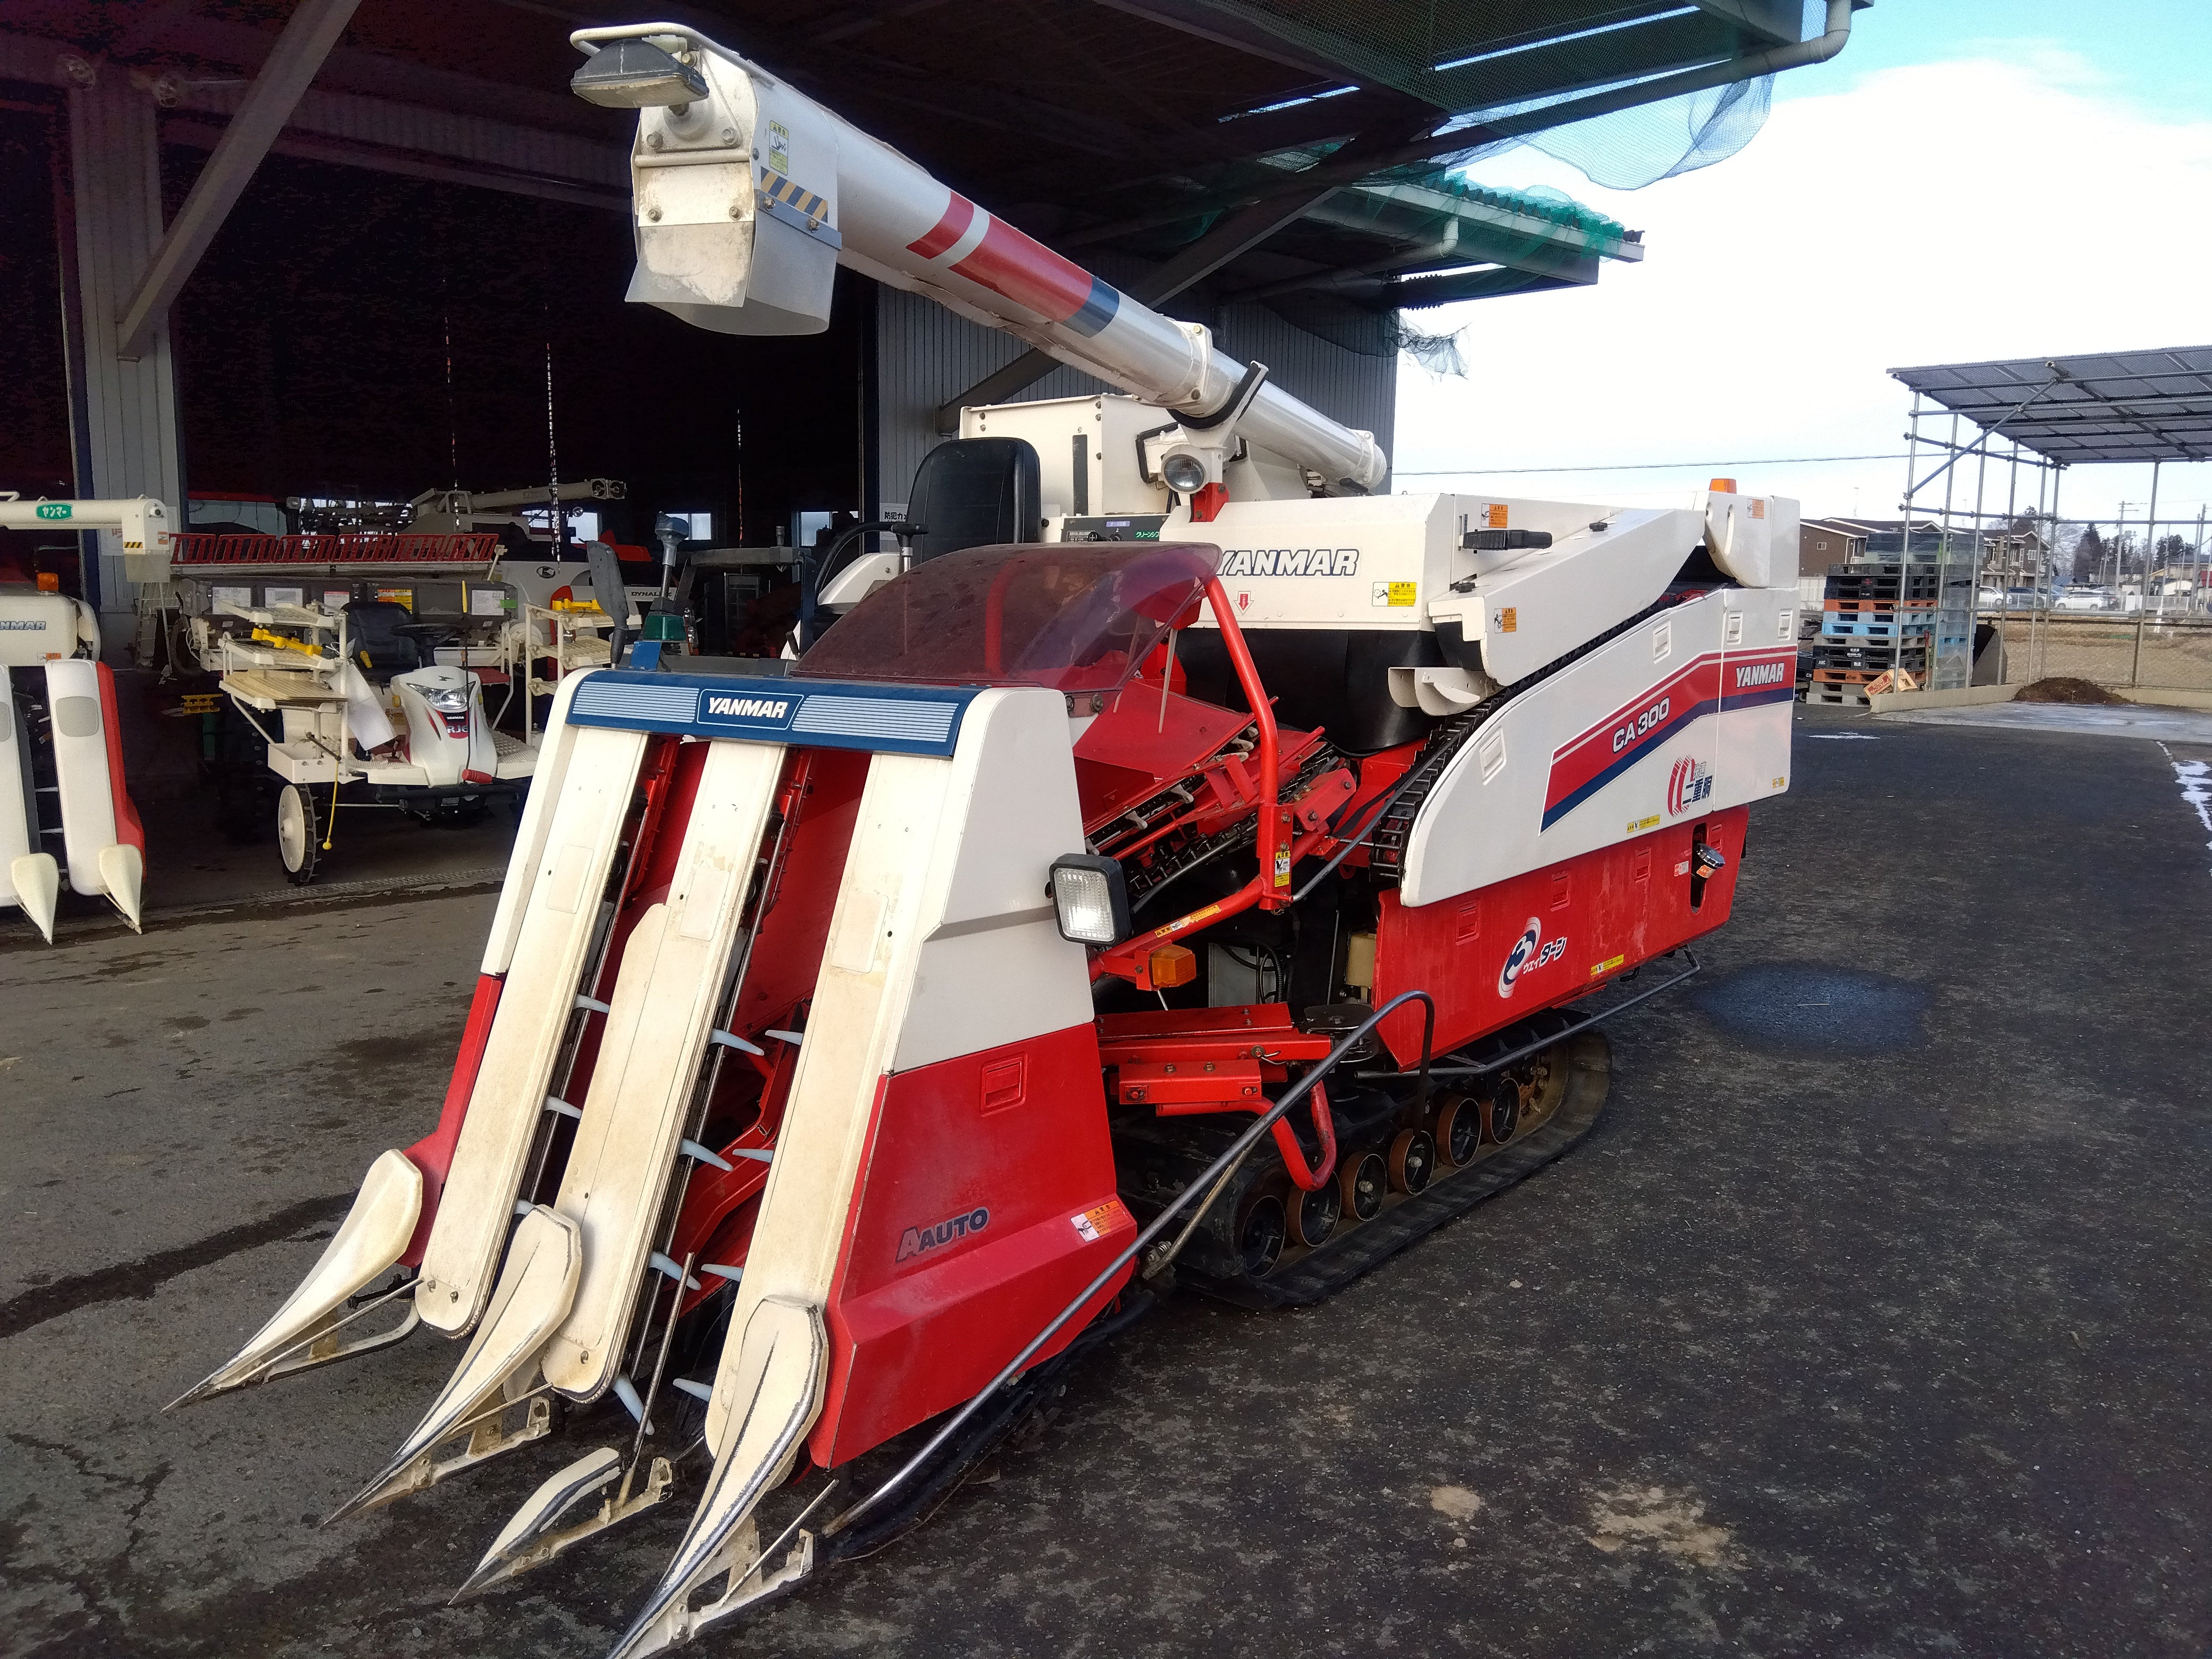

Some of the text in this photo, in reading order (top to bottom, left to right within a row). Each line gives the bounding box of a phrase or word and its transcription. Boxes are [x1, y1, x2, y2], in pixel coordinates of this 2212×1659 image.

[42, 506, 67, 517] ヤンマー
[1736, 663, 1784, 689] YANMAR
[708, 697, 788, 718] YANMAR
